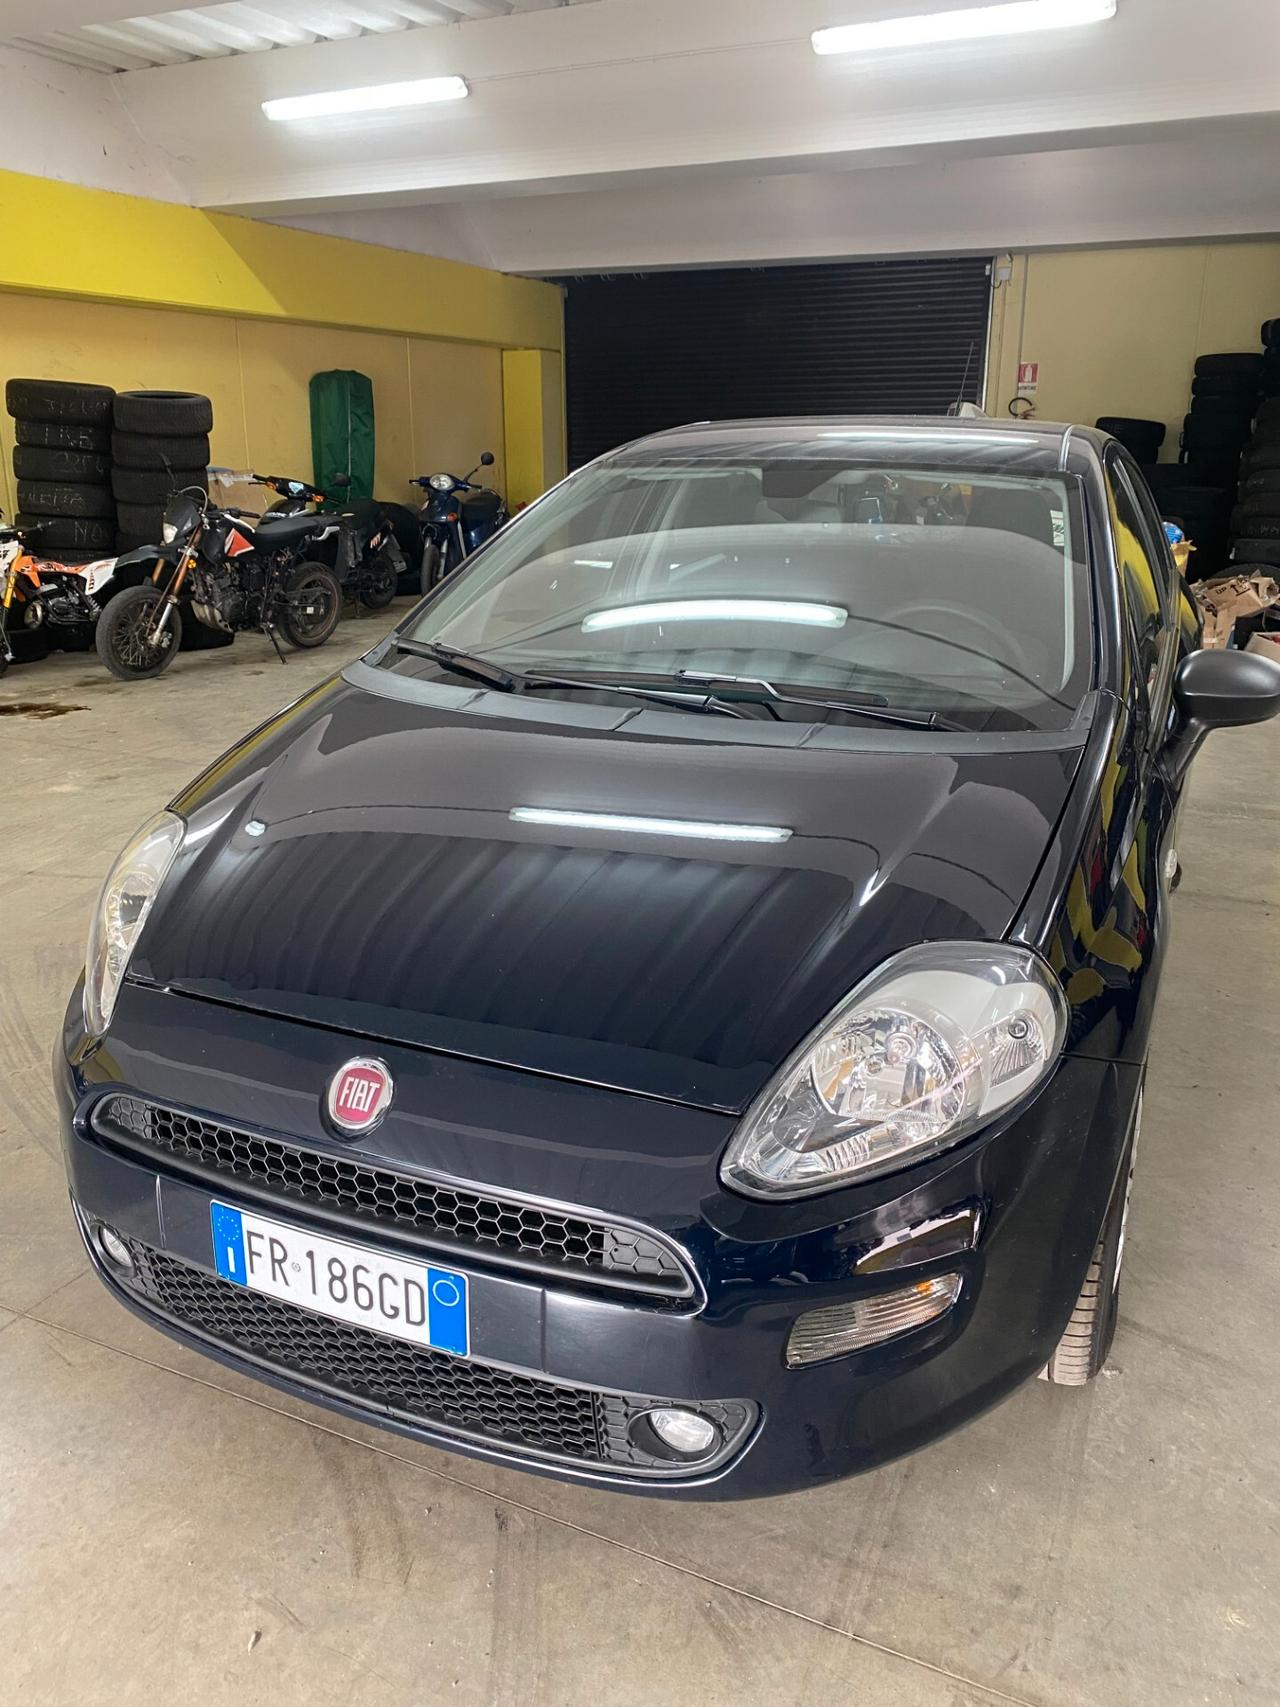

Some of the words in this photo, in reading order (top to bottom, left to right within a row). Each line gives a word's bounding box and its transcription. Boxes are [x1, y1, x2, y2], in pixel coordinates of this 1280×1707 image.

[338, 1076, 381, 1113] FIAT
[227, 1246, 236, 1274] I
[246, 1230, 290, 1287] FR
[306, 1249, 426, 1327] 186GD
